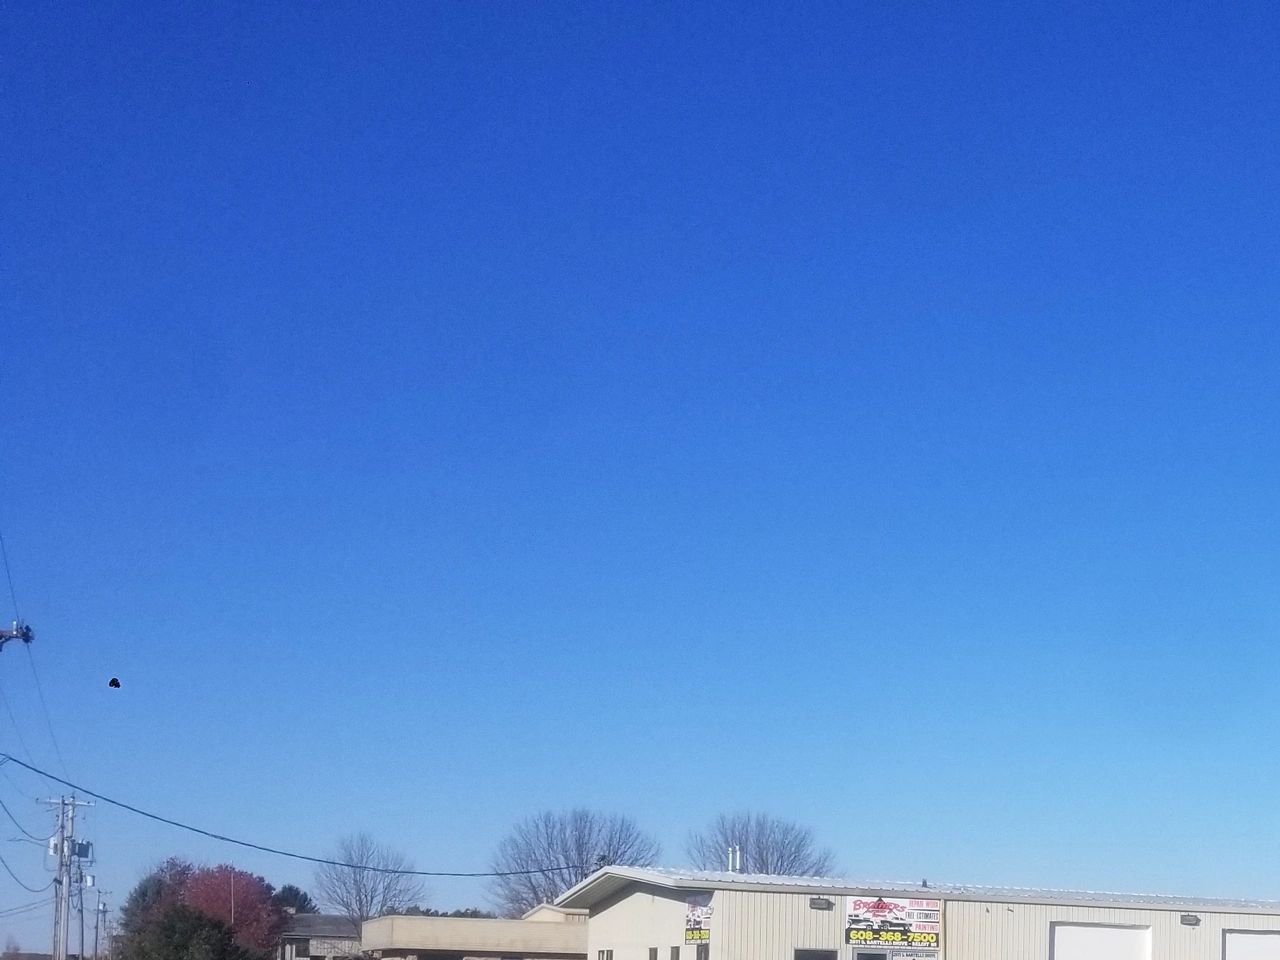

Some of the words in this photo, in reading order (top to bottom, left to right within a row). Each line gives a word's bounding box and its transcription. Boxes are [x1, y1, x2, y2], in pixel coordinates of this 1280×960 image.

[905, 911, 915, 920] FREE
[916, 911, 939, 921] ESTIMATES
[914, 923, 939, 932] PAINTING
[849, 930, 937, 943] 608-368-7500
